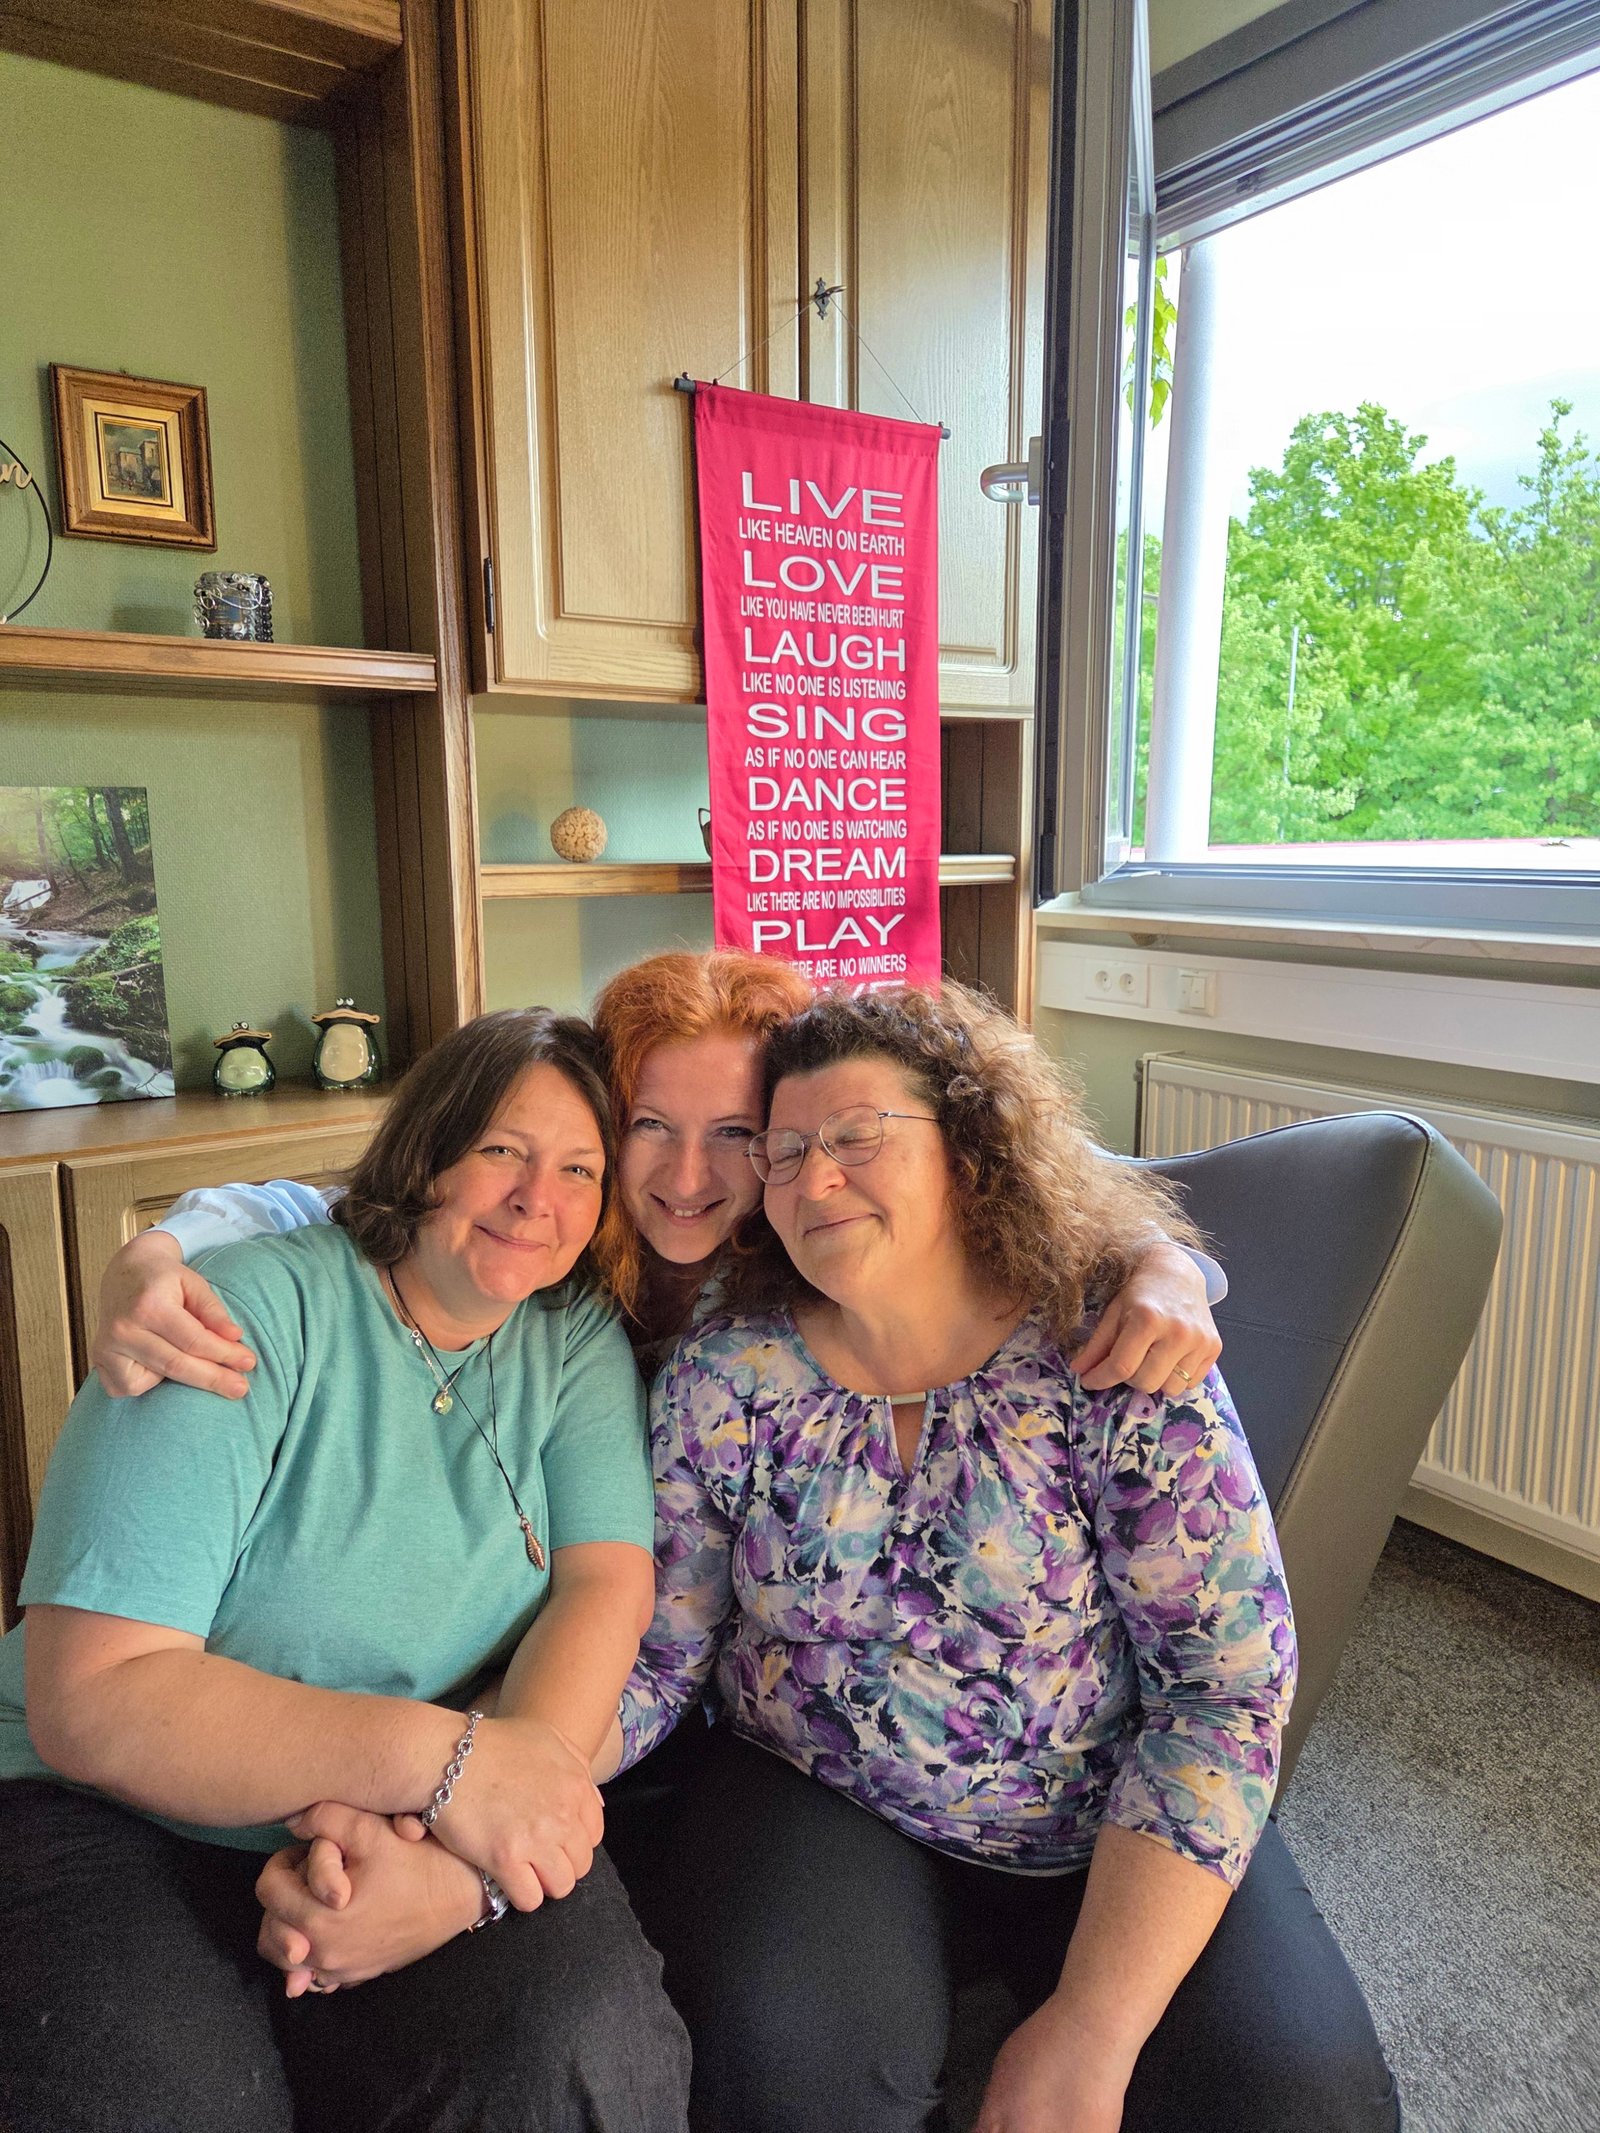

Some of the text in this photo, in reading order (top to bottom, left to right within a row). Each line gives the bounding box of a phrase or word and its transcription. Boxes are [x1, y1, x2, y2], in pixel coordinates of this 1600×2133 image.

[741, 471, 905, 528] LIVE
[738, 517, 905, 556] LIKE HEAVEN ON EARTH
[743, 550, 905, 601] LOVE
[741, 595, 904, 629] LIKE YOU HAVE NEVER BEEN HURT
[744, 626, 906, 672] LAUGH
[743, 672, 906, 700] LIKE NO ONE IS LISTENING
[746, 703, 906, 742] SING
[745, 747, 906, 770] AS IF NO ONE CAN HEAR
[748, 776, 906, 812] DANCE
[747, 820, 907, 841] AS IF NO ONE IS WATCHING
[749, 847, 906, 883] DREAM
[747, 887, 905, 912] LIKE THERE ARE NO IMPOSSIBILITIES
[753, 913, 905, 953] PLAY
[789, 954, 906, 978] ERE ARE NO WINNERS
